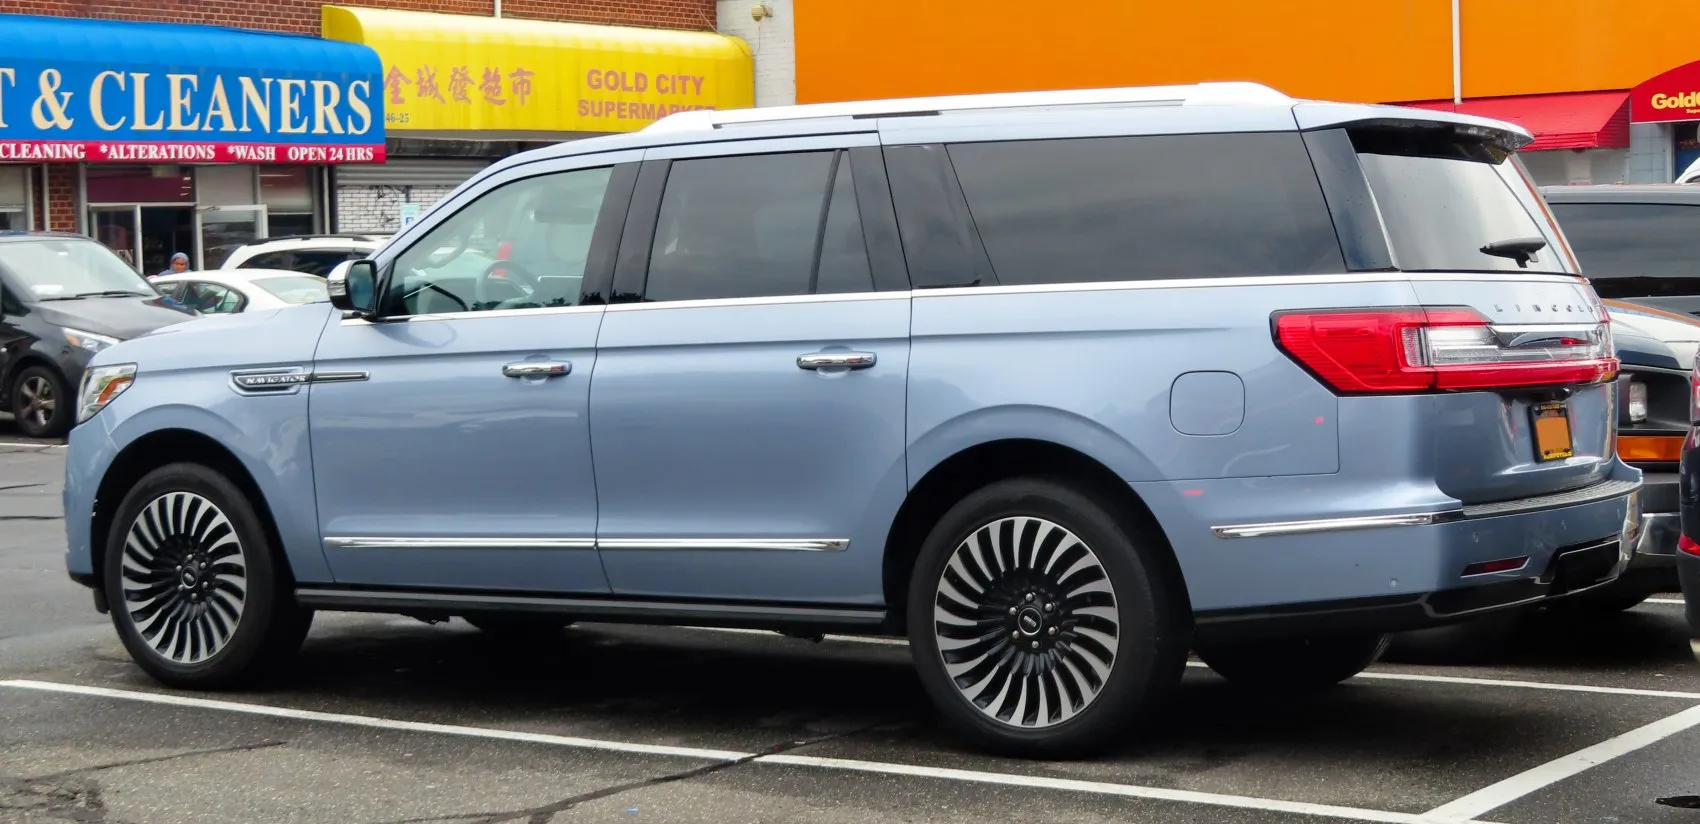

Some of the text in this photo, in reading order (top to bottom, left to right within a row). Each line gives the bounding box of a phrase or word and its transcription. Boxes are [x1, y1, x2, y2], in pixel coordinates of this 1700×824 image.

[587, 69, 705, 96] GOLD CITY
[31, 68, 74, 130] &
[89, 70, 372, 135] CLEANERS
[0, 143, 86, 160] CLEANING
[288, 146, 326, 161] OPEN
[329, 146, 344, 161] 24
[346, 147, 374, 161] HRS
